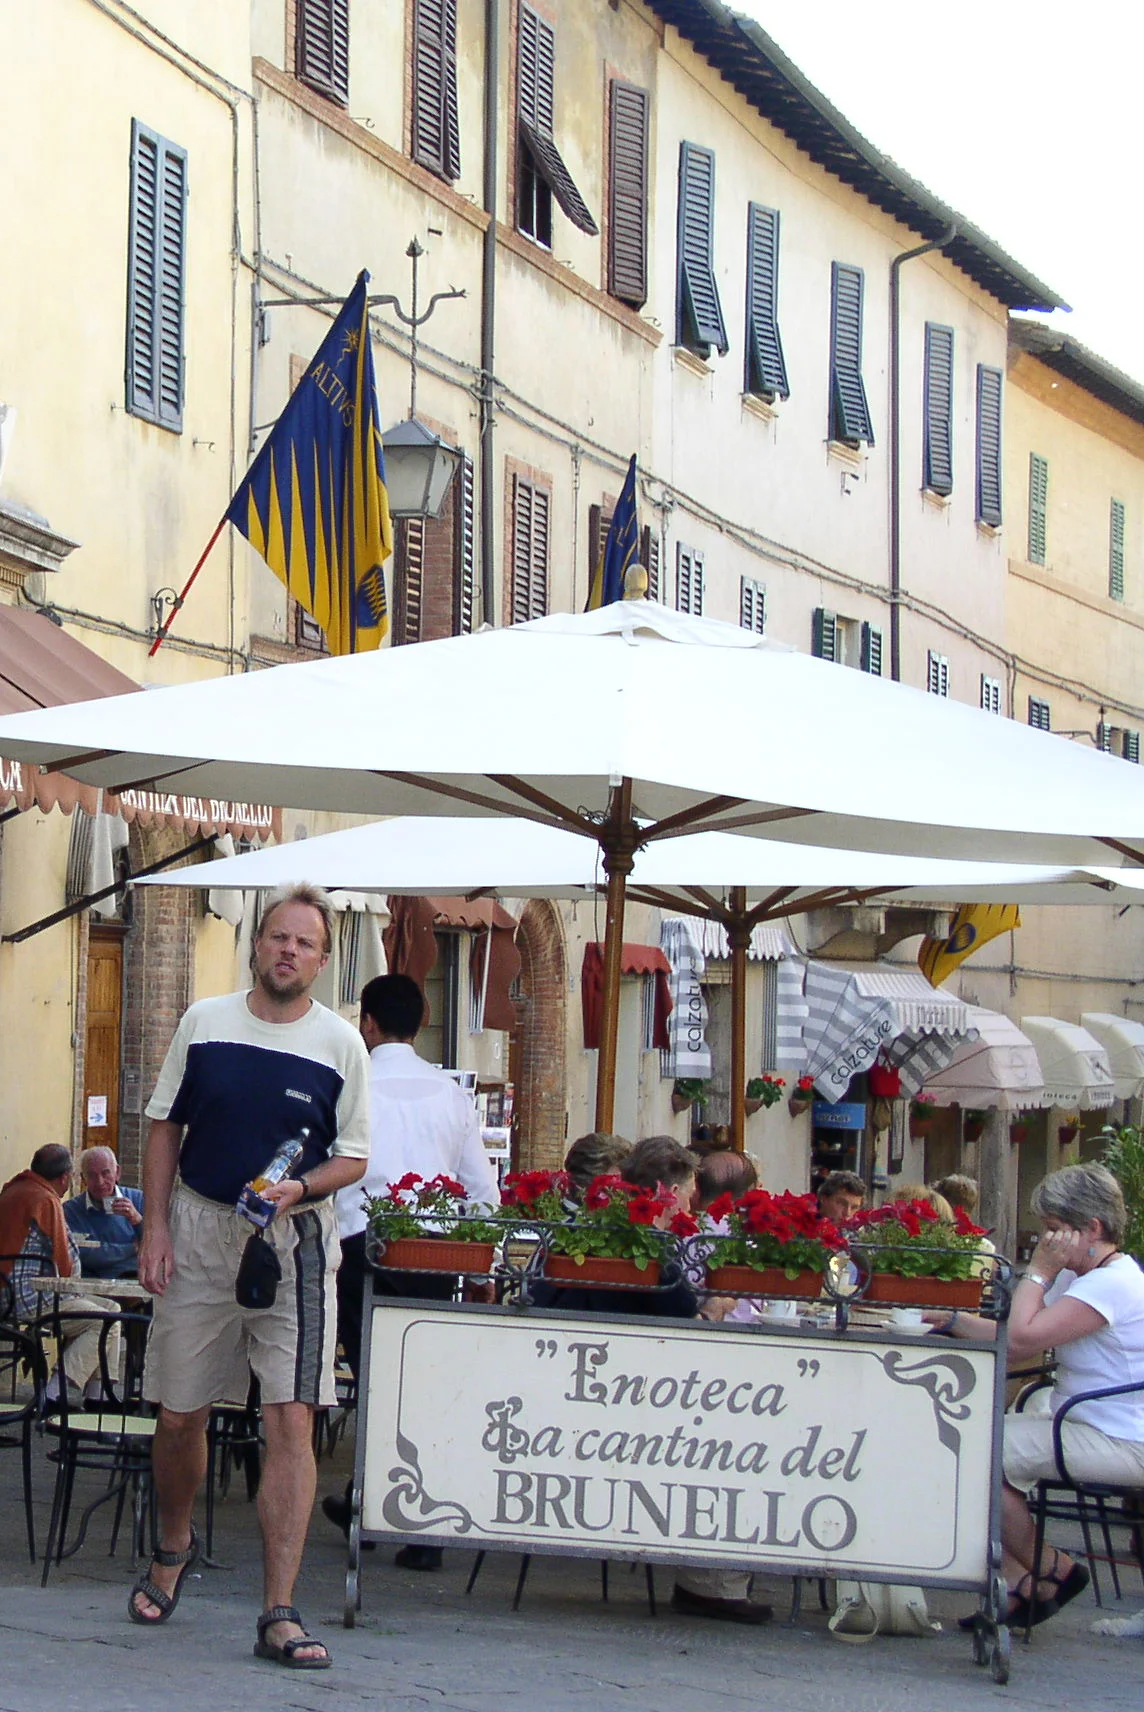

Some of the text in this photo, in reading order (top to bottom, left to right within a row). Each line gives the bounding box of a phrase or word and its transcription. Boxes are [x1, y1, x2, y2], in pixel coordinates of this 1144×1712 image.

[830, 1019, 892, 1086] calzature
[574, 1414, 782, 1474] cantina
[779, 1423, 868, 1482] del
[490, 1469, 859, 1552] BRUNELLO
